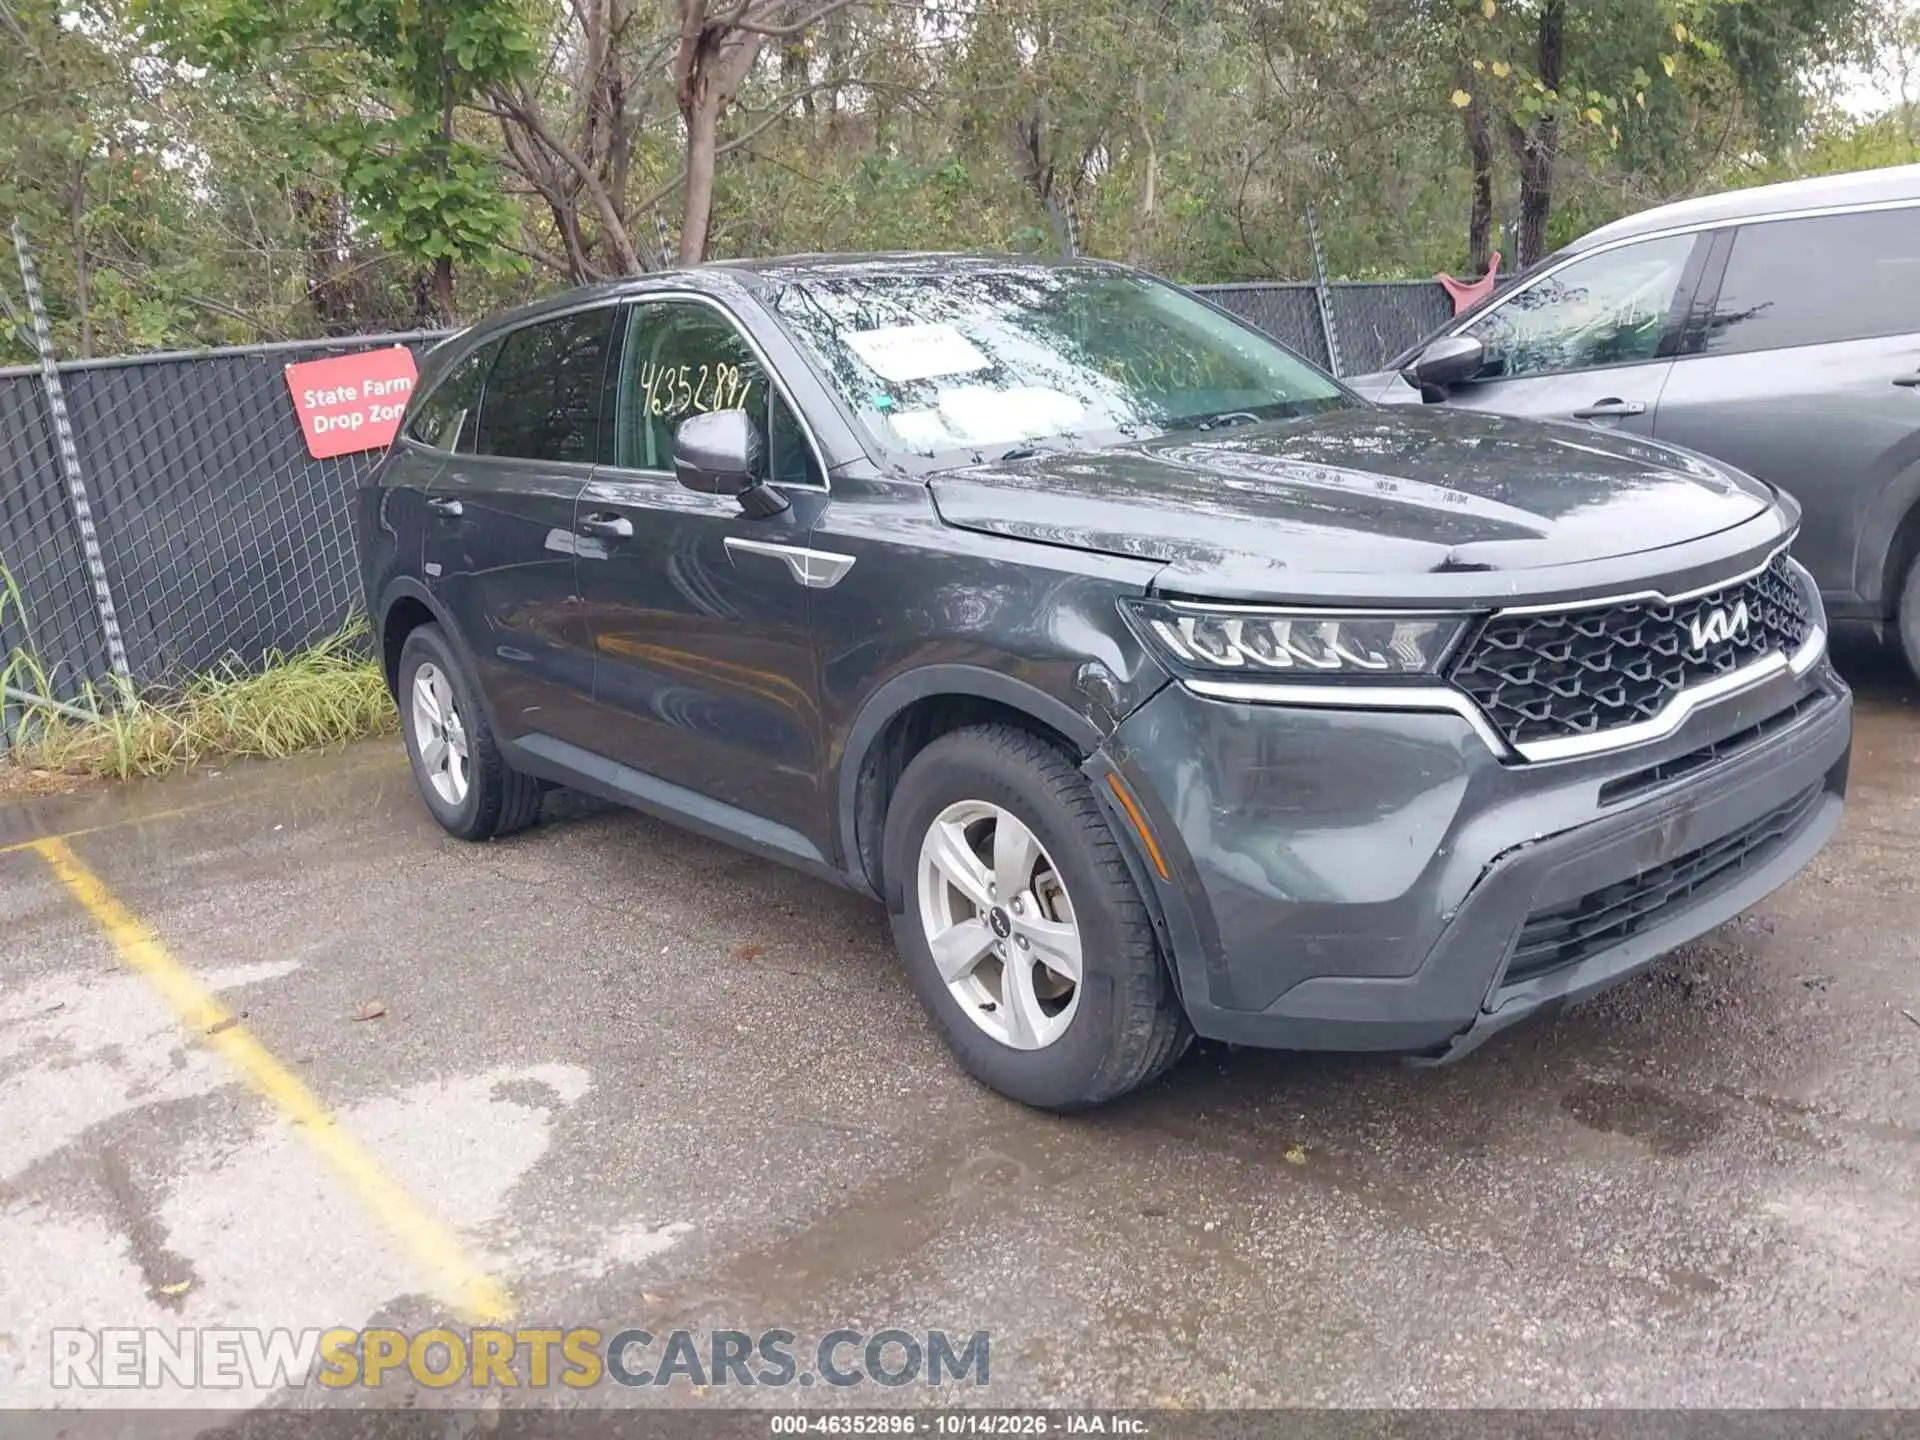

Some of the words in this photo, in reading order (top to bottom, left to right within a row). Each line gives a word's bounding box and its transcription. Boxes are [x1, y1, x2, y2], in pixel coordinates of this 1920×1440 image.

[303, 385, 357, 409] State
[363, 377, 411, 398] Farm
[313, 411, 364, 434] Drop
[368, 402, 406, 423] Zon
